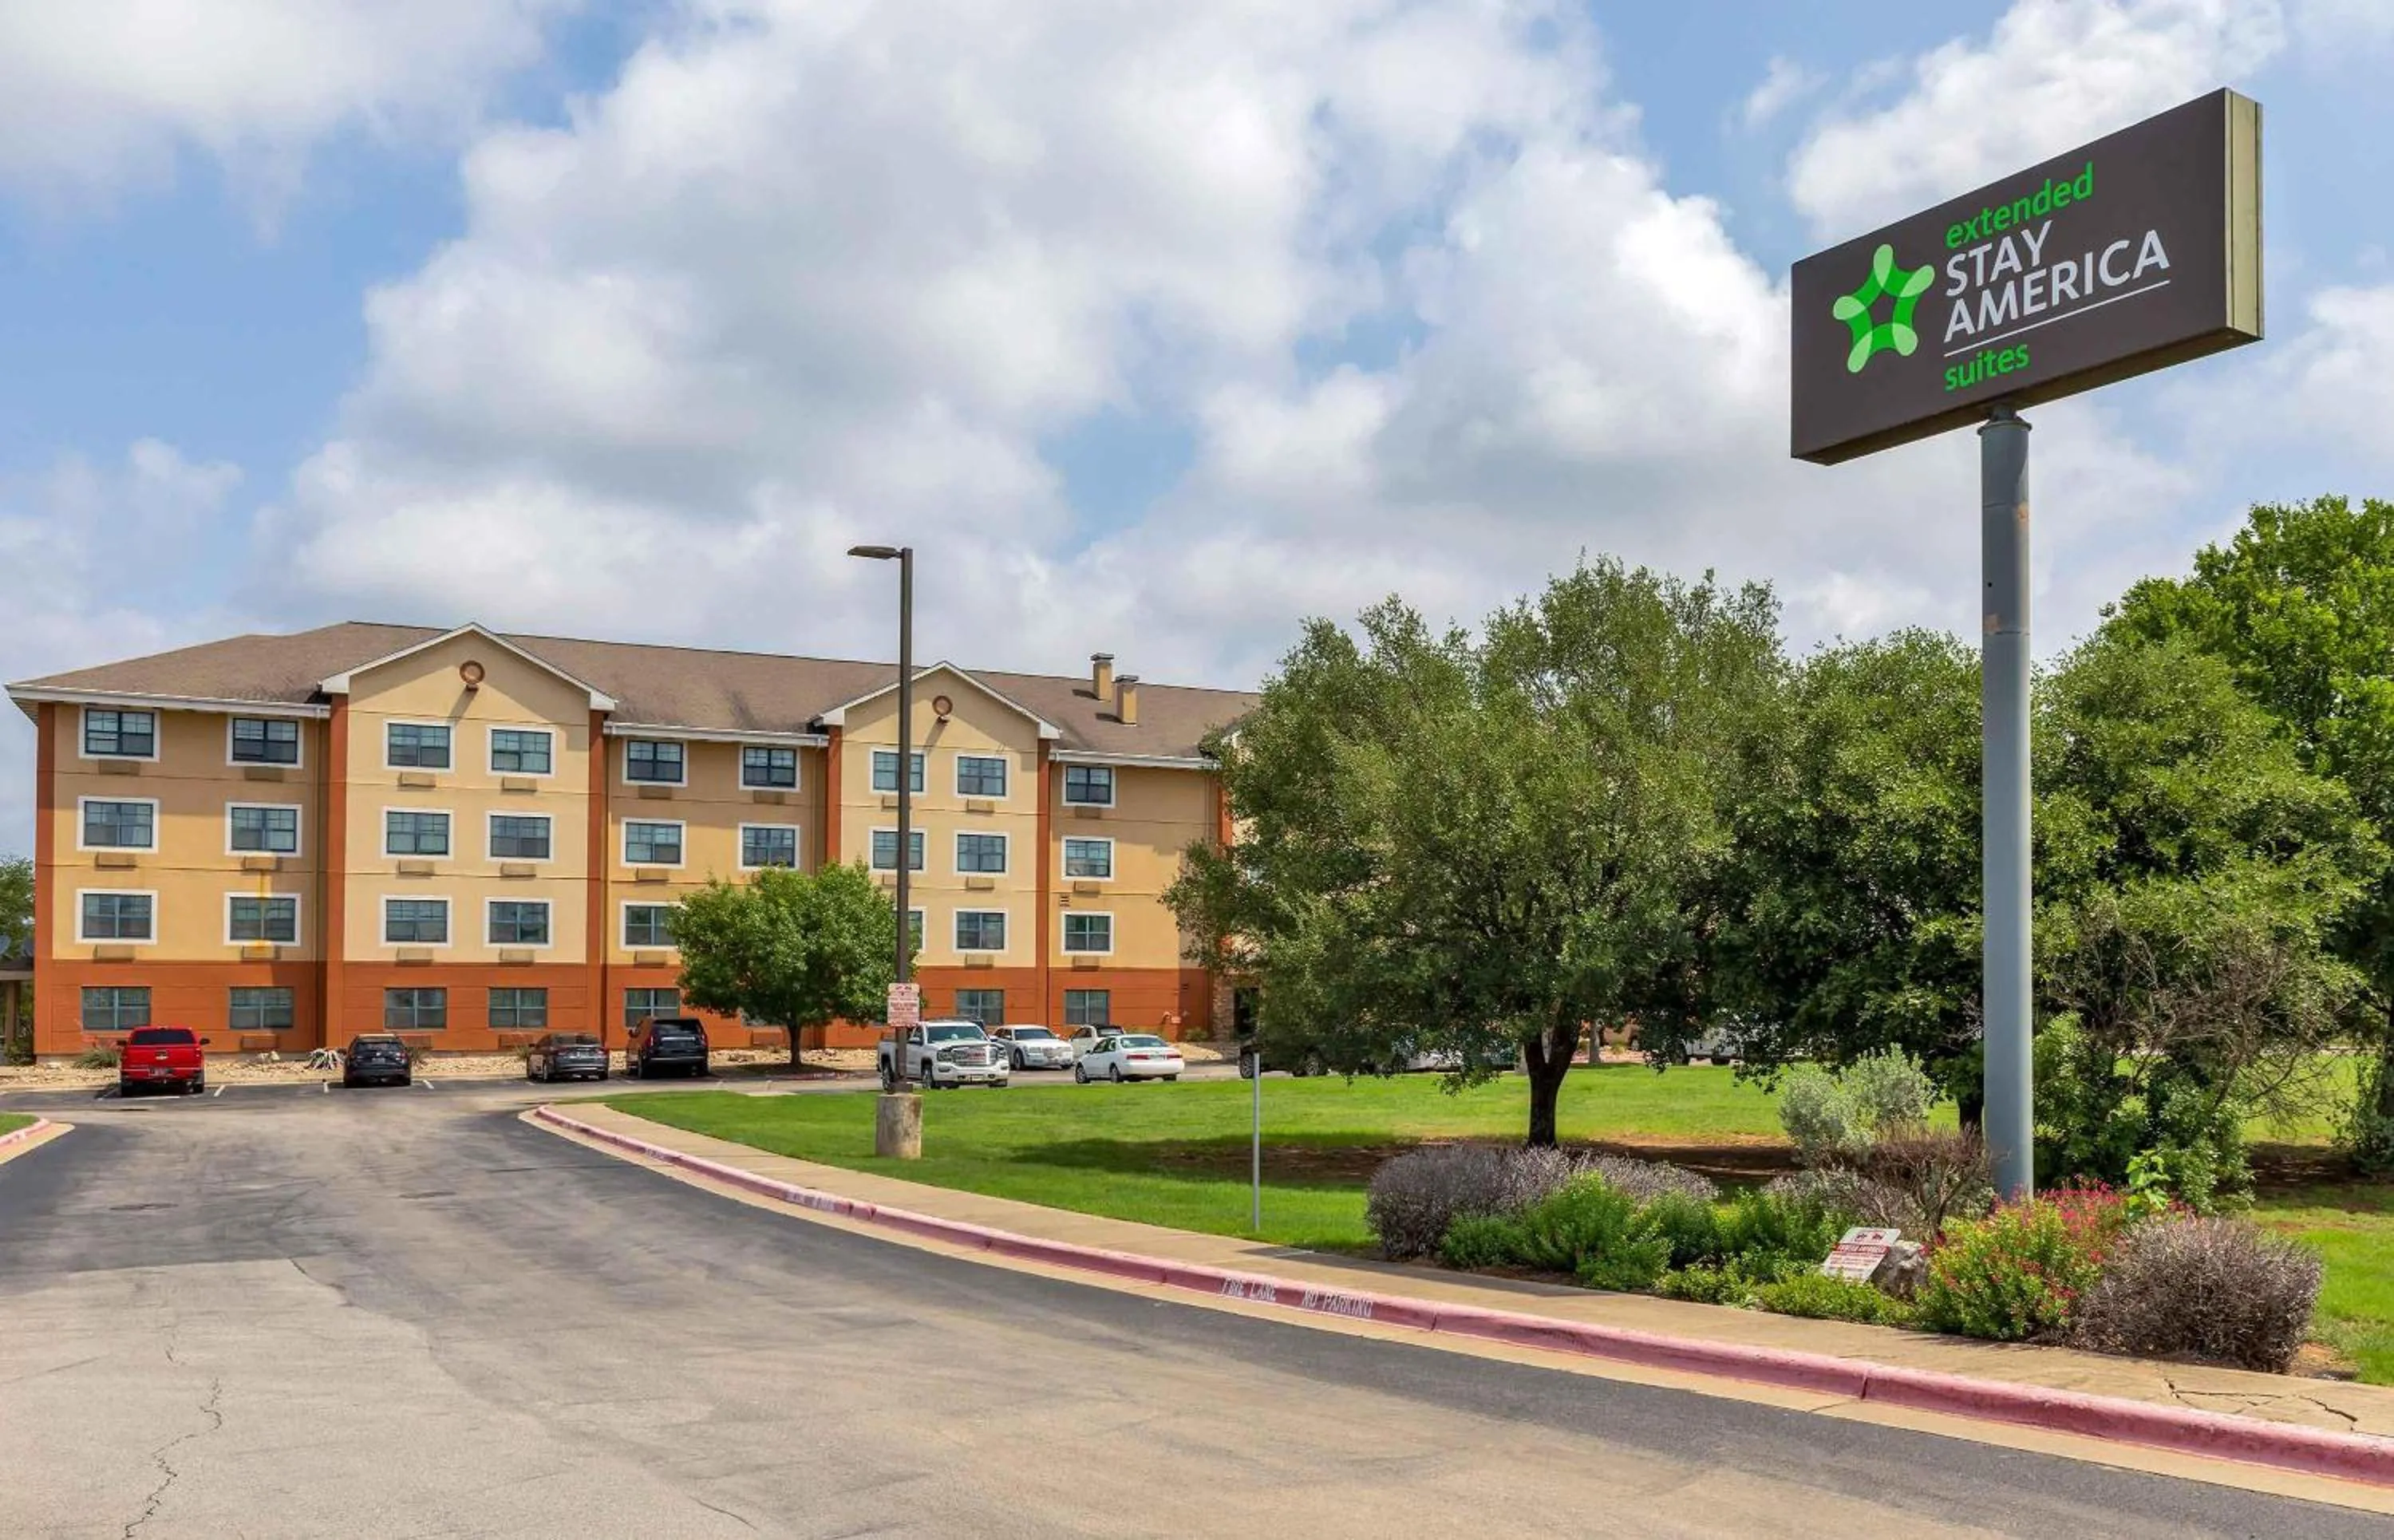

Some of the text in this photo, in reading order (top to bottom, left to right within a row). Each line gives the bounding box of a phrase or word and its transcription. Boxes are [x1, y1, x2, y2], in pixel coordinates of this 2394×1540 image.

[1946, 162, 2092, 249] extended
[1944, 230, 2171, 343] AMERICA
[1946, 220, 2052, 296] STAY
[1944, 345, 2029, 391] suites
[1250, 1281, 1276, 1301] LANE
[1302, 1289, 1319, 1309] NO
[1322, 1291, 1373, 1317] PARKING
